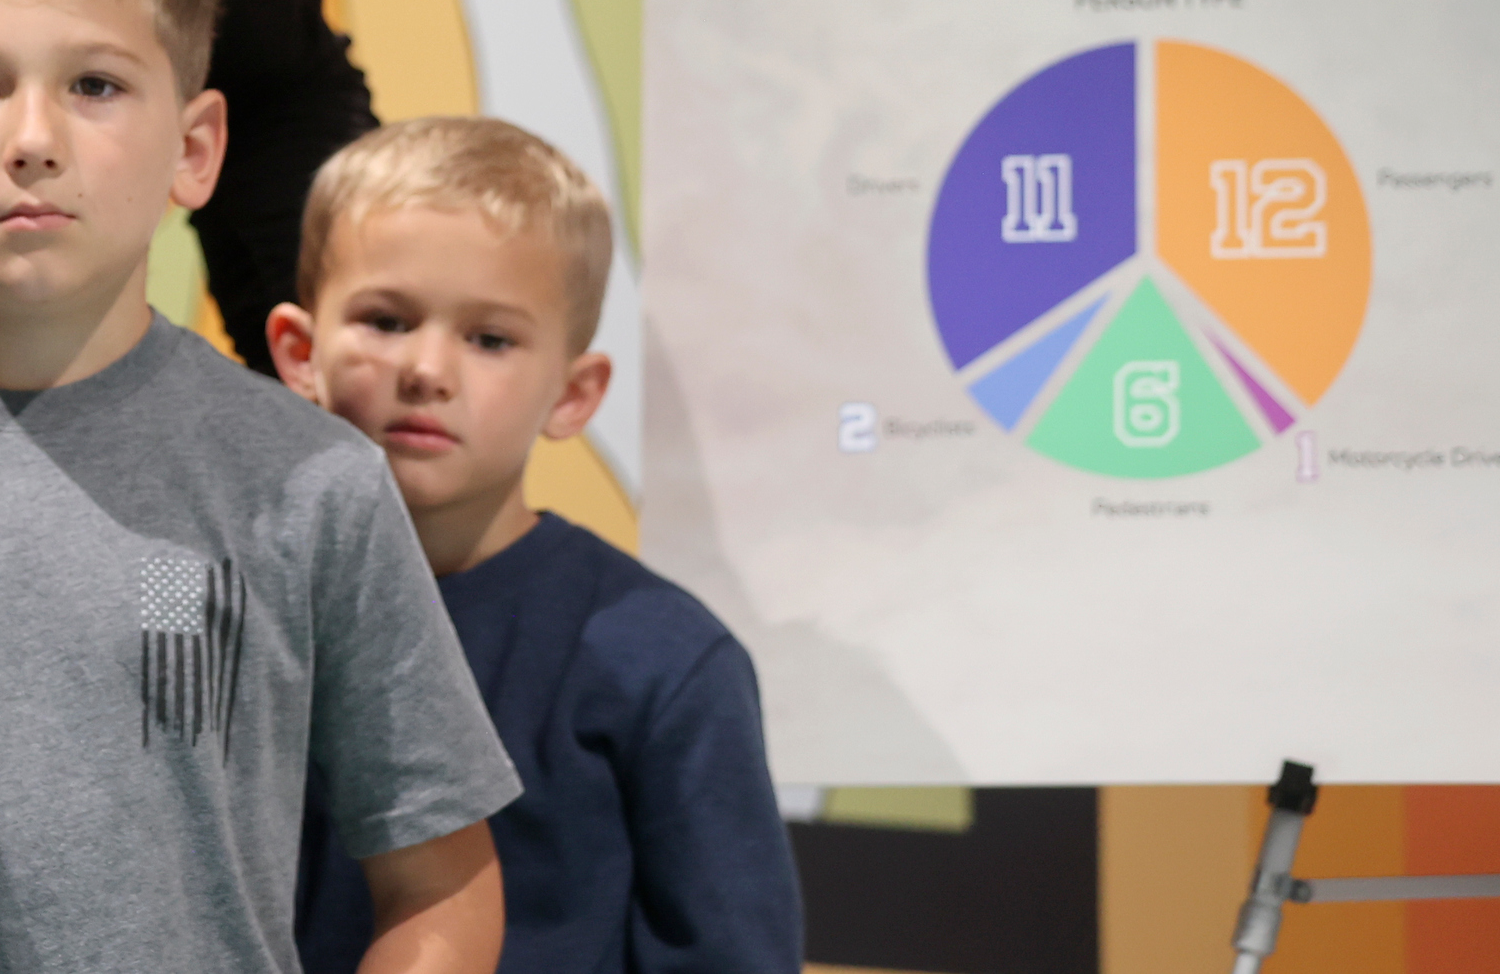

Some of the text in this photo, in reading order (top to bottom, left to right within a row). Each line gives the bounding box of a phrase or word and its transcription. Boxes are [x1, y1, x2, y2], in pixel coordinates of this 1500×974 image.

[1000, 153, 1078, 243] 11
[1376, 166, 1495, 193] Passengers
[1209, 158, 1327, 260] 12
[837, 400, 878, 454] 2
[1112, 359, 1181, 448] 6
[1295, 430, 1320, 483] 1
[1327, 447, 1445, 472] Motorcycle
[1089, 495, 1211, 520] Pedestrians
